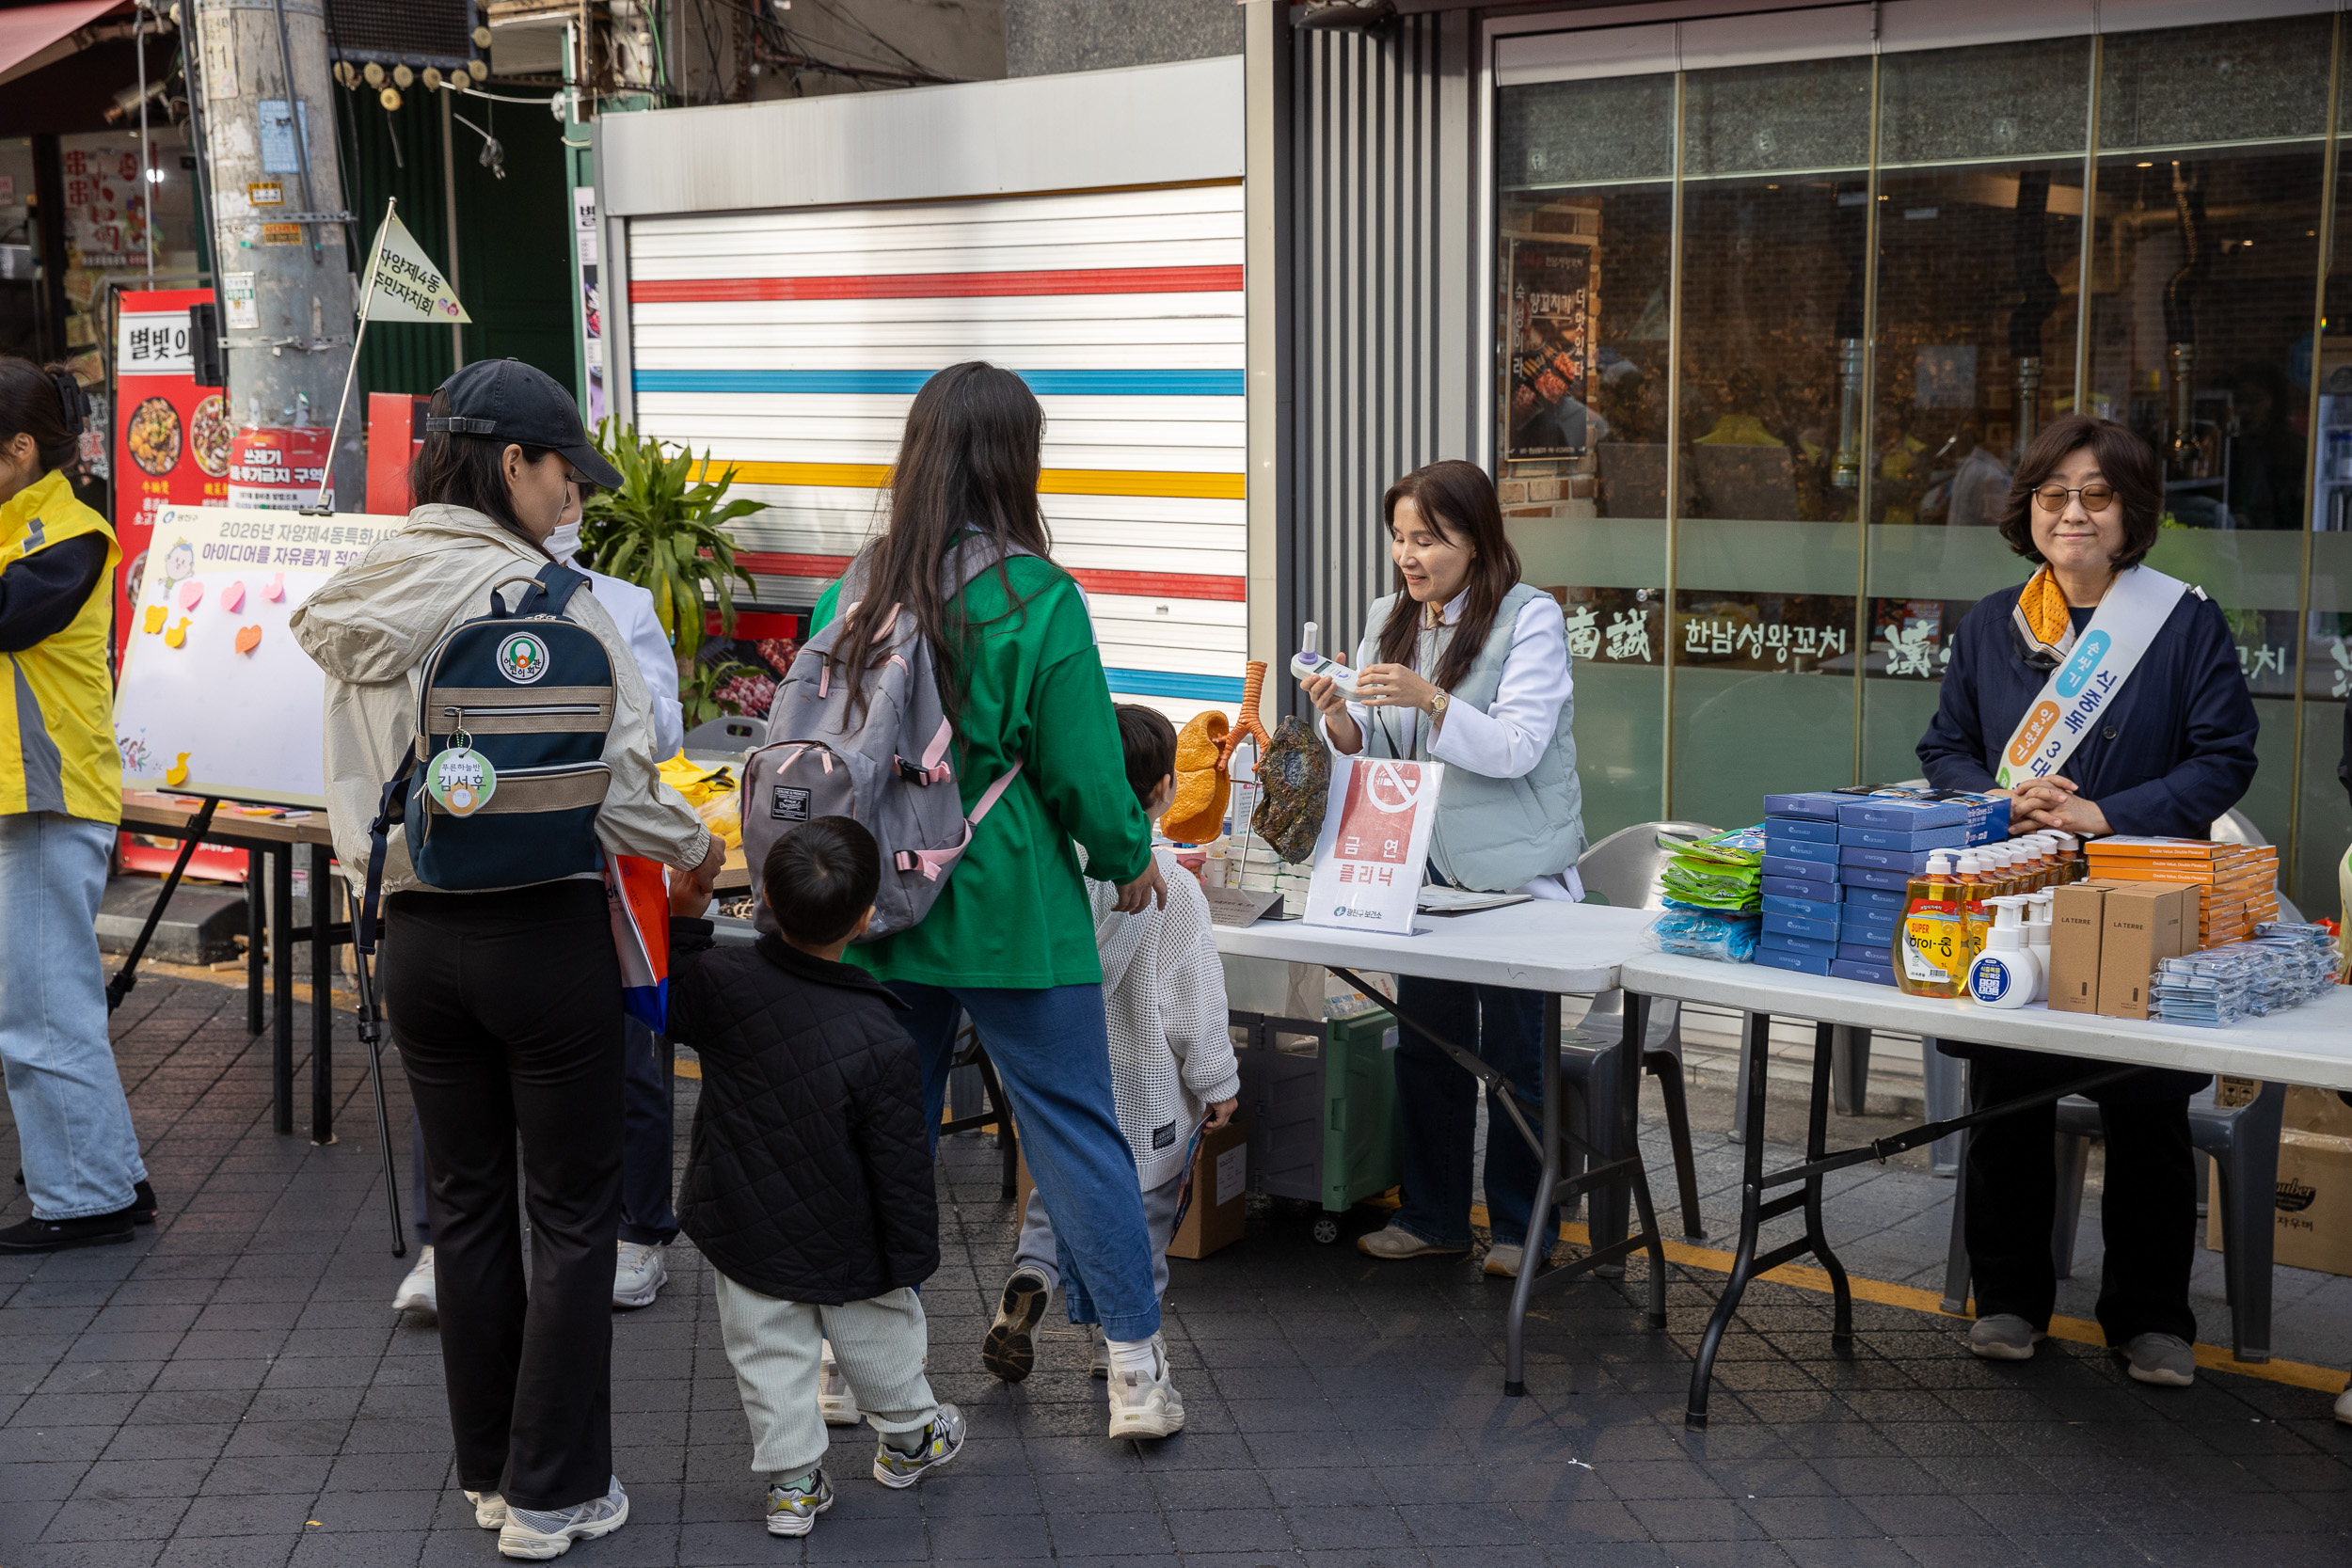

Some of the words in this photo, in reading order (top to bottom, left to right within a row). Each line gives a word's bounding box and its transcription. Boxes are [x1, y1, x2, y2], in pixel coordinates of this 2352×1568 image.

[377, 248, 440, 293] 자양제4동
[371, 271, 435, 316] 주민자치회
[243, 449, 282, 466] 쓰레기
[294, 467, 325, 483] 구역
[219, 521, 275, 541] 2026년
[202, 543, 271, 565] 아이디어를
[273, 546, 330, 567] 자유롭게
[1685, 618, 1847, 664] 한남성왕꼬치
[503, 657, 542, 677] 어린이회관
[2069, 641, 2100, 688] 손씻기
[2064, 670, 2118, 735] 식중독
[441, 763, 481, 772] 푸른하늘반
[437, 774, 486, 792] 김서후
[1339, 863, 1393, 887] 클리닉
[1346, 909, 1364, 918] 광진구
[1364, 910, 1382, 919] 보건소
[1912, 922, 1930, 934] SUPER
[2277, 1215, 2313, 1232] 자우버
